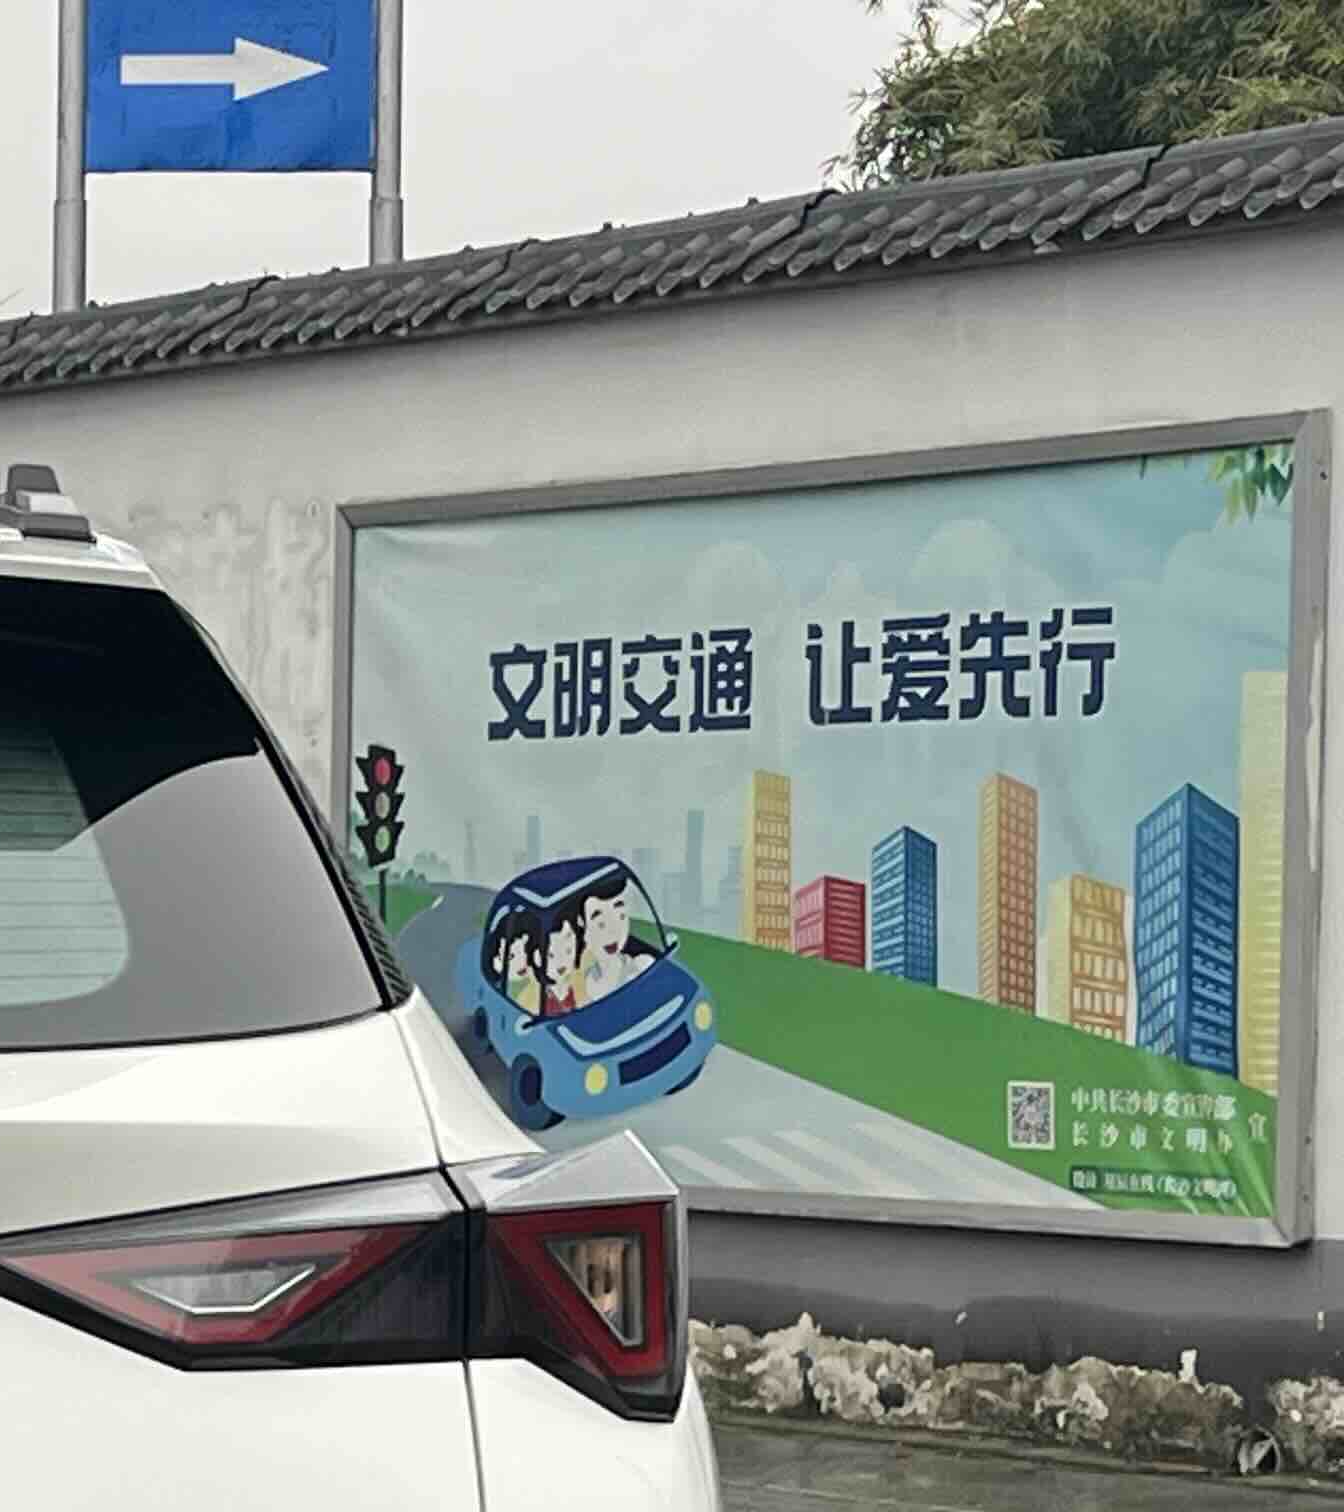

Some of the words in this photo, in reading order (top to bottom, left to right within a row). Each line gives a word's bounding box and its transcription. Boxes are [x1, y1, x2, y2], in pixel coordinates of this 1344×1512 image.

[487, 629, 752, 740] 文明交通
[805, 606, 1115, 726] 让爱先行
